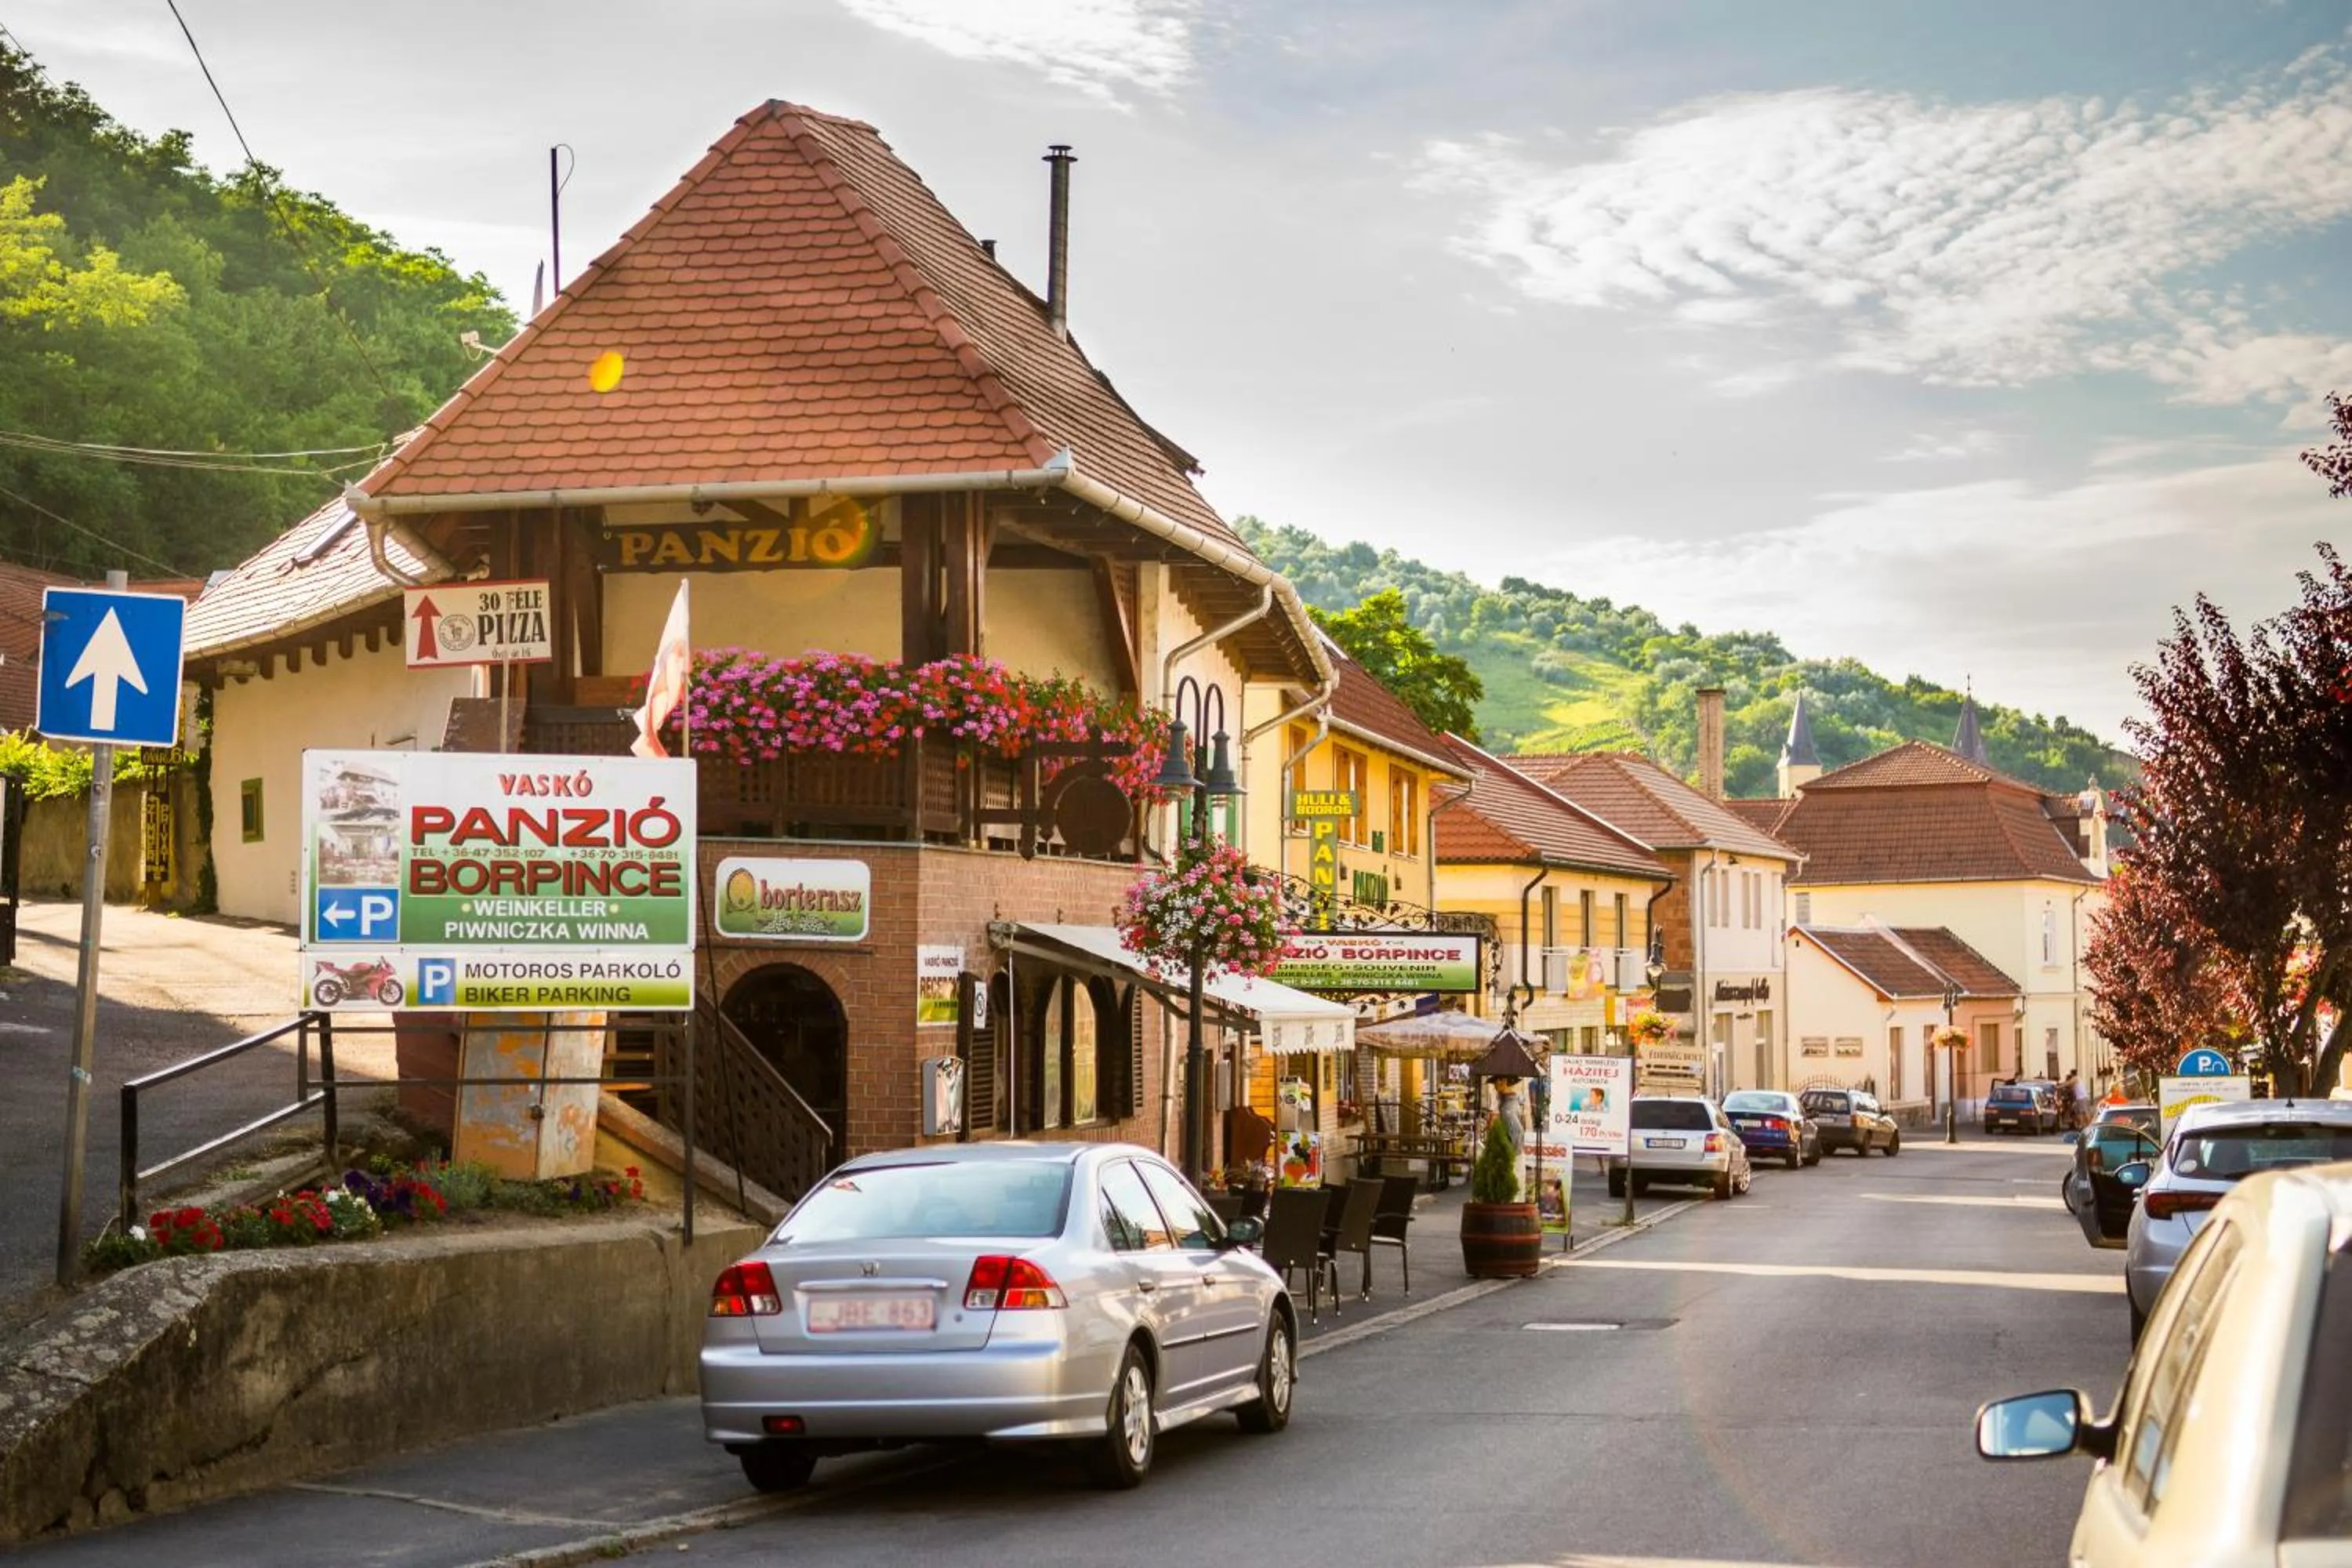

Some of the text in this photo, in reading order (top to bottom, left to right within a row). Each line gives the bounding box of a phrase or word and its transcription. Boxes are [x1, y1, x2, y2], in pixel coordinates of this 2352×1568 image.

[620, 523, 857, 564] PANZIÓ
[478, 588, 543, 612] 30 FÉLE
[477, 612, 546, 645] PIZZA
[498, 770, 593, 797] VASKÓ
[1297, 793, 1351, 805] HULI &
[411, 797, 682, 848] PANZIÓ
[409, 860, 682, 897] BORPINCE
[759, 879, 862, 913] borterasz
[361, 896, 394, 935] P
[474, 899, 607, 918] WEINKELLER
[444, 920, 650, 939] PIWNICZKA WINNA
[1290, 946, 1461, 961] ZIÓ BORPINCE
[465, 960, 681, 979] MOTOROS PARKOLÓ
[1278, 962, 1343, 971] DESSÉG
[424, 964, 452, 998] P
[465, 986, 631, 1004] BIKER PARKING
[2198, 1056, 2212, 1073] P
[1555, 1113, 1578, 1123] 0-24
[1580, 1127, 1597, 1137] 170
